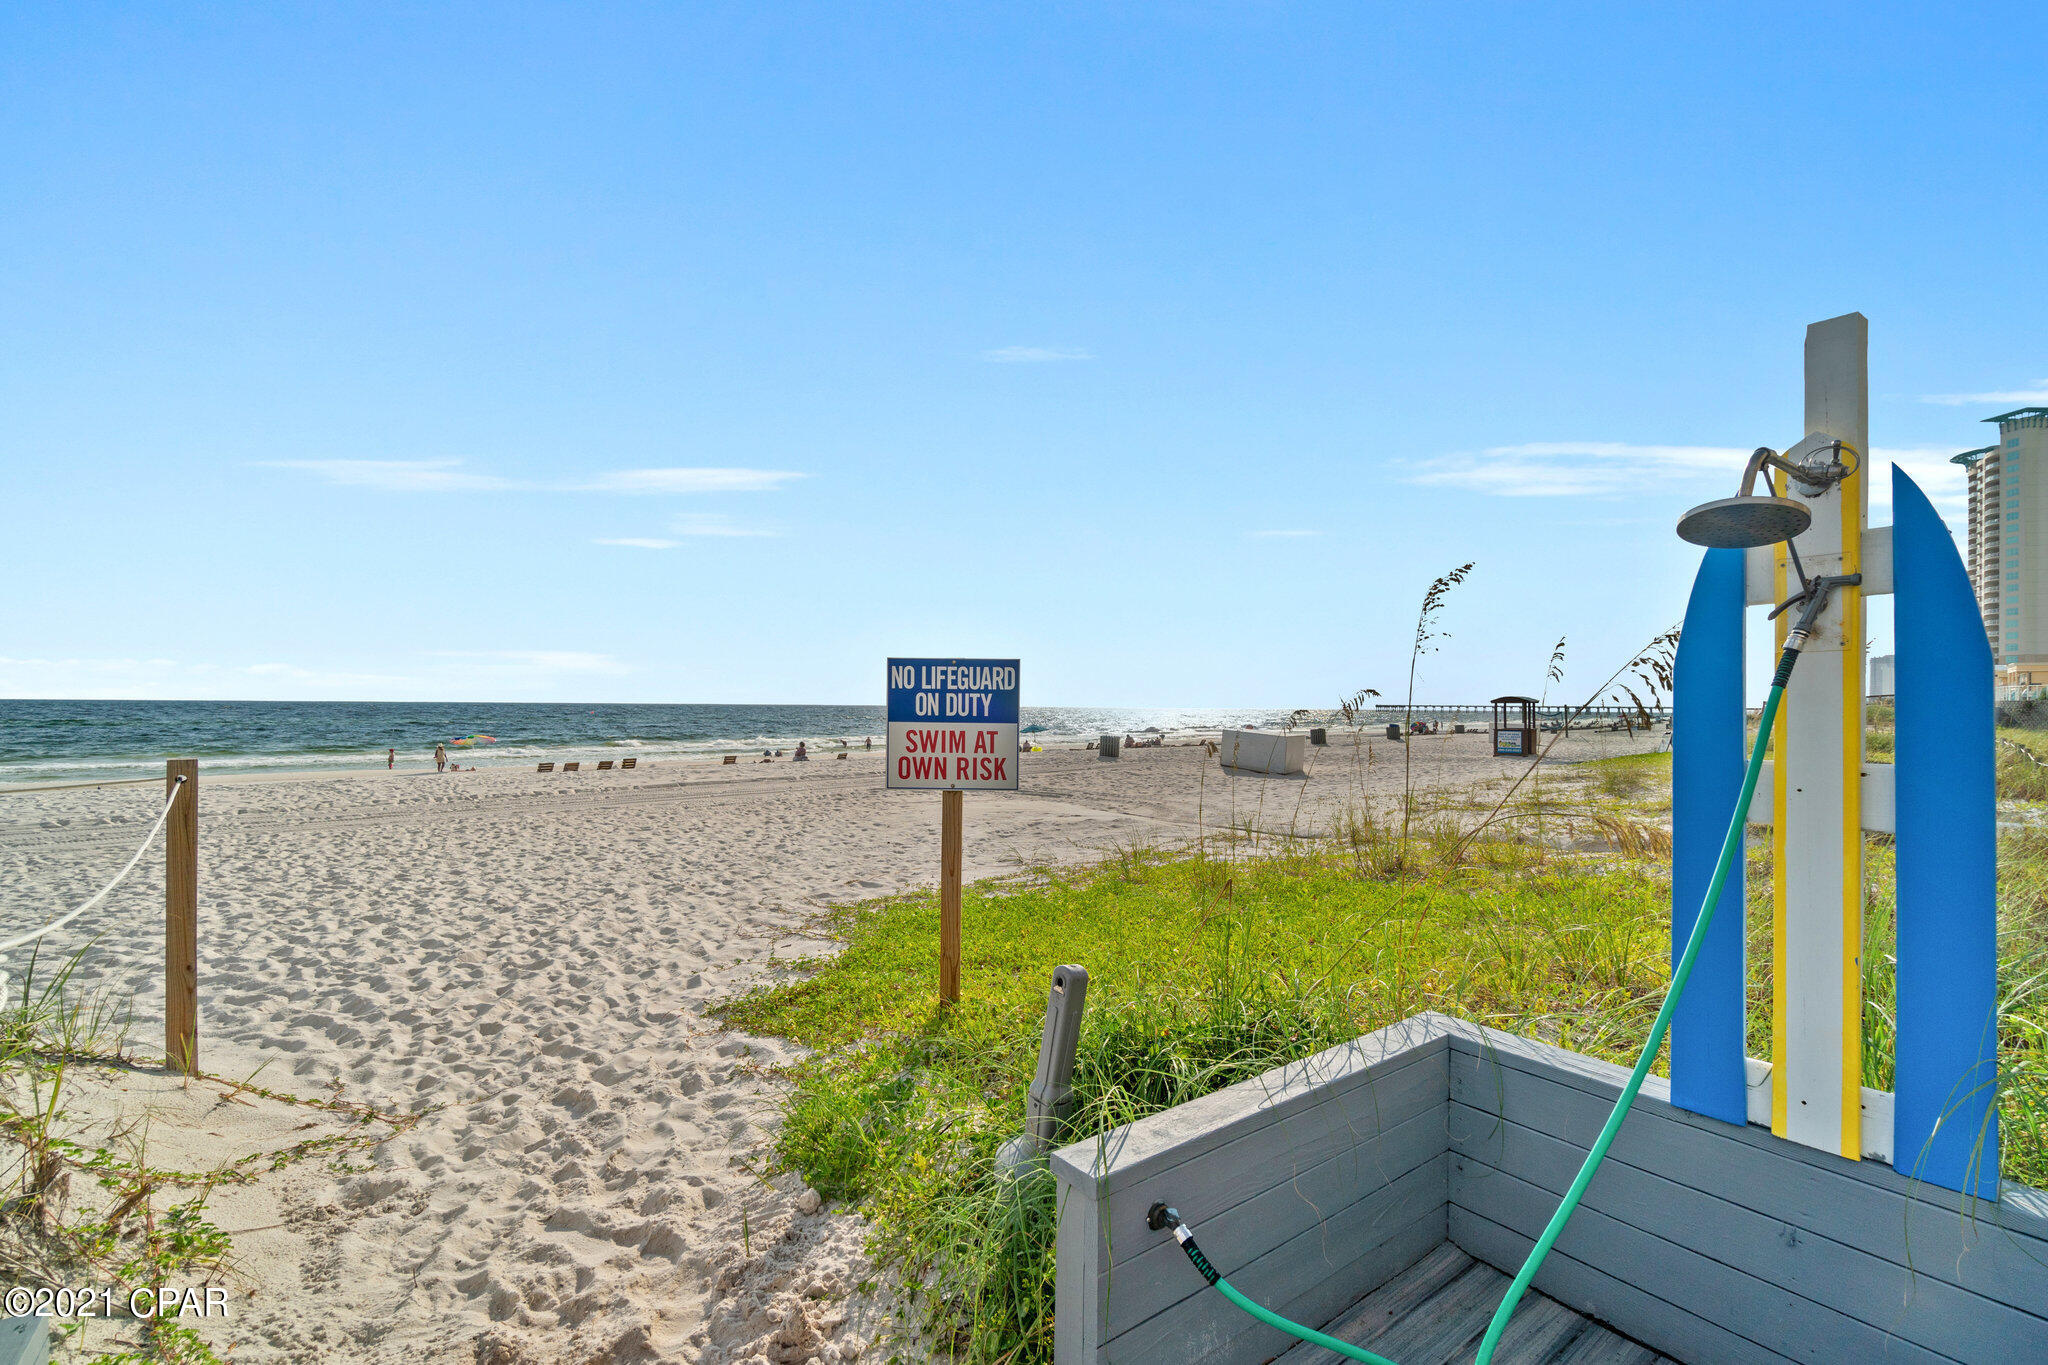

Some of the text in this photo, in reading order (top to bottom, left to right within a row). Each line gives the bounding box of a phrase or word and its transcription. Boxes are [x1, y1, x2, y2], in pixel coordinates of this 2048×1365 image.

[891, 665, 1016, 690] NO LIFEGUARD
[915, 692, 993, 717] ON DUTY
[905, 729, 999, 754] SWIM AT
[898, 756, 1007, 781] OWN RISK
